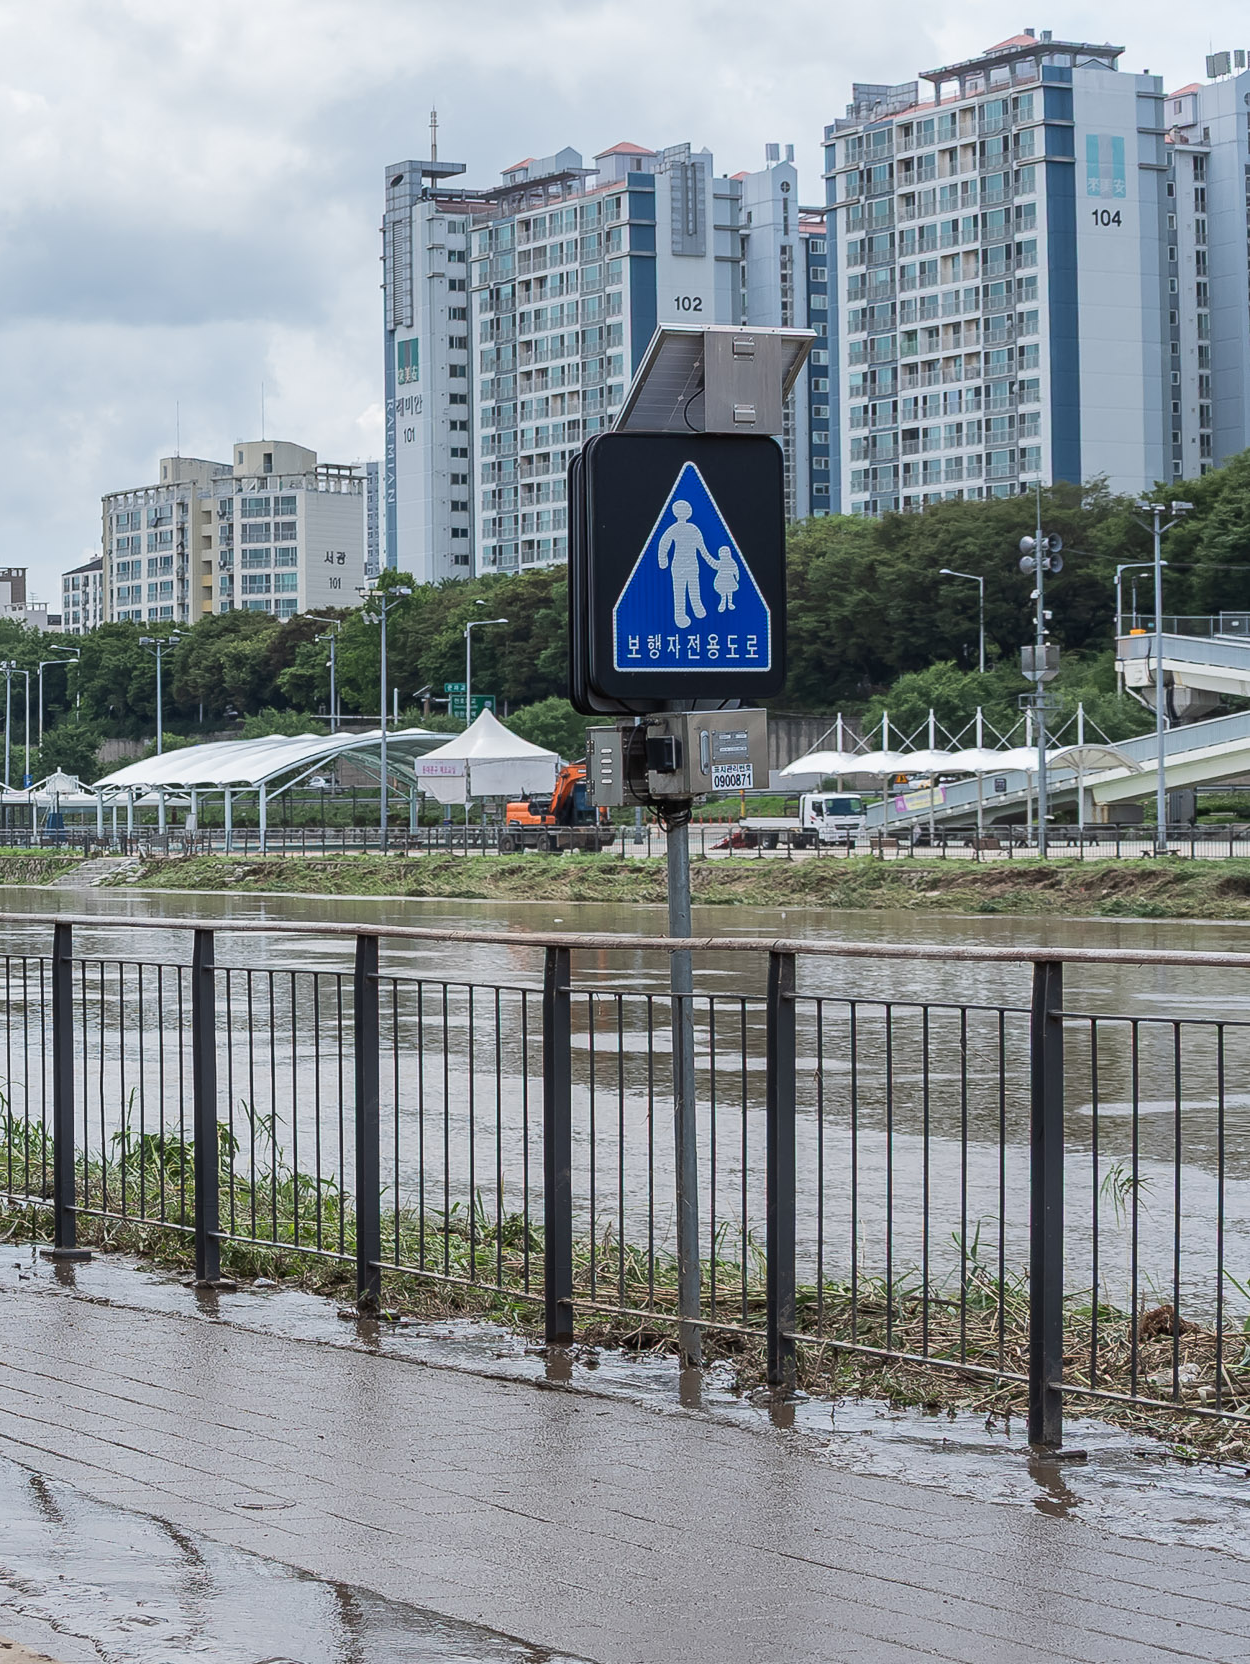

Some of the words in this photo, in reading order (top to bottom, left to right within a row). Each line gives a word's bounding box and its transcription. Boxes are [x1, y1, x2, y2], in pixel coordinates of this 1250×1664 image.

[1092, 208, 1122, 227] 104
[674, 296, 703, 312] 102
[396, 394, 423, 417] 래미안
[403, 426, 416, 443] 101
[386, 398, 396, 504] RAEMIAN
[324, 551, 346, 565] 서광
[329, 577, 341, 589] 101
[627, 633, 759, 659] 보행자전용도로
[714, 773, 751, 788] 0900871
